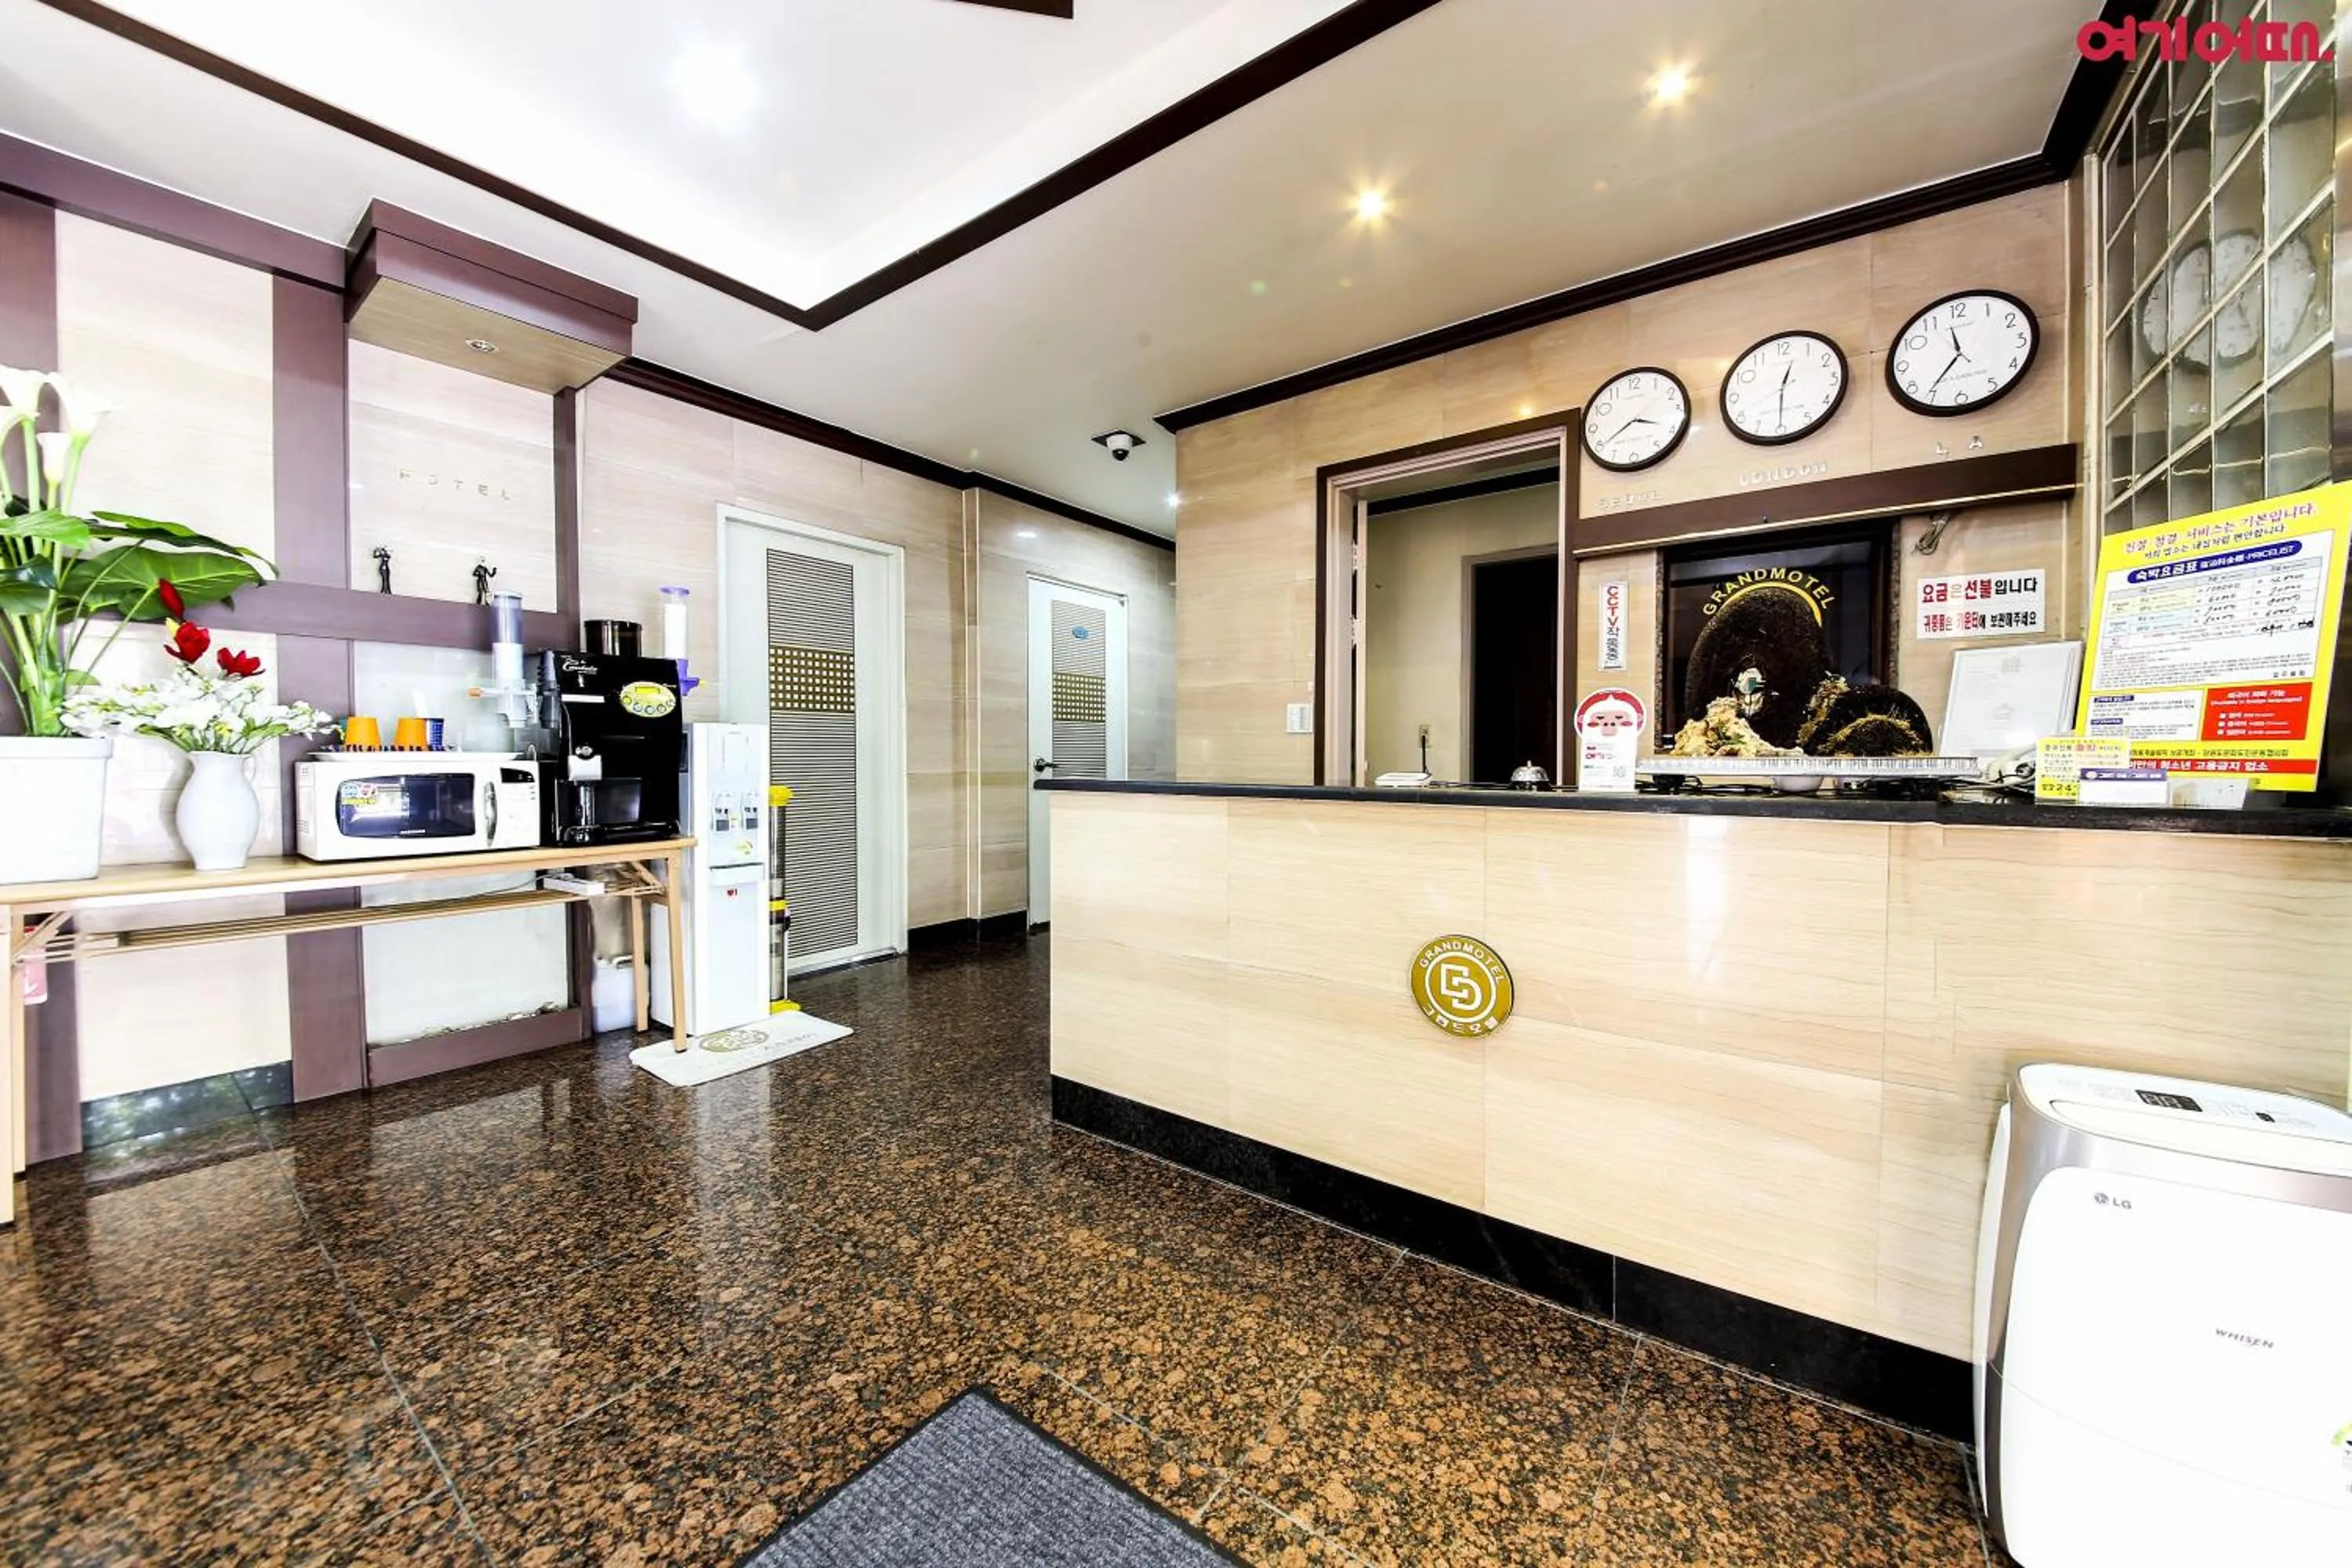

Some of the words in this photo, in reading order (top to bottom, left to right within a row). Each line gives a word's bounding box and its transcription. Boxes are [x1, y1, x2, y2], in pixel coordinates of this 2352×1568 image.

[1950, 303, 1966, 318] 12
[1923, 316, 1937, 332] 11
[2005, 313, 2016, 328] 2
[1904, 336, 1928, 351] 10
[2016, 332, 2027, 349] 3
[1777, 342, 1790, 357] 12
[1753, 354, 1765, 366] 11
[1821, 353, 1831, 368] 2
[1896, 360, 1909, 375] 9
[2009, 356, 2018, 370] 4
[1628, 376, 1641, 390] 12
[1737, 369, 1756, 385] 10
[1830, 372, 1838, 387] 3
[1907, 380, 1918, 394] 8
[1987, 377, 1998, 394] 5
[1610, 387, 1619, 400] 11
[1668, 387, 1675, 400] 2
[1729, 393, 1740, 405] 9
[1822, 394, 1830, 405] 4
[1929, 390, 1937, 405] 7
[1955, 390, 1969, 405] 6
[1595, 402, 1612, 416] 10
[1736, 410, 1746, 424] 8
[1804, 412, 1813, 426] 5
[1588, 423, 1598, 435] 9
[1755, 420, 1762, 434] 7
[1595, 441, 1604, 453] 8
[1611, 450, 1617, 461] 7
[1629, 452, 1639, 463] 6
[1738, 462, 1827, 486] LONDON
[2187, 521, 2235, 540] 서비스는
[2136, 561, 2198, 582] 숙박요금표
[1703, 568, 1835, 615] GRANDMOTEL
[2245, 761, 2269, 771] 업소
[1419, 940, 1504, 982] GRANDMOTEL
[2113, 1198, 2132, 1210] LG
[2216, 1328, 2274, 1348] WHISEN
